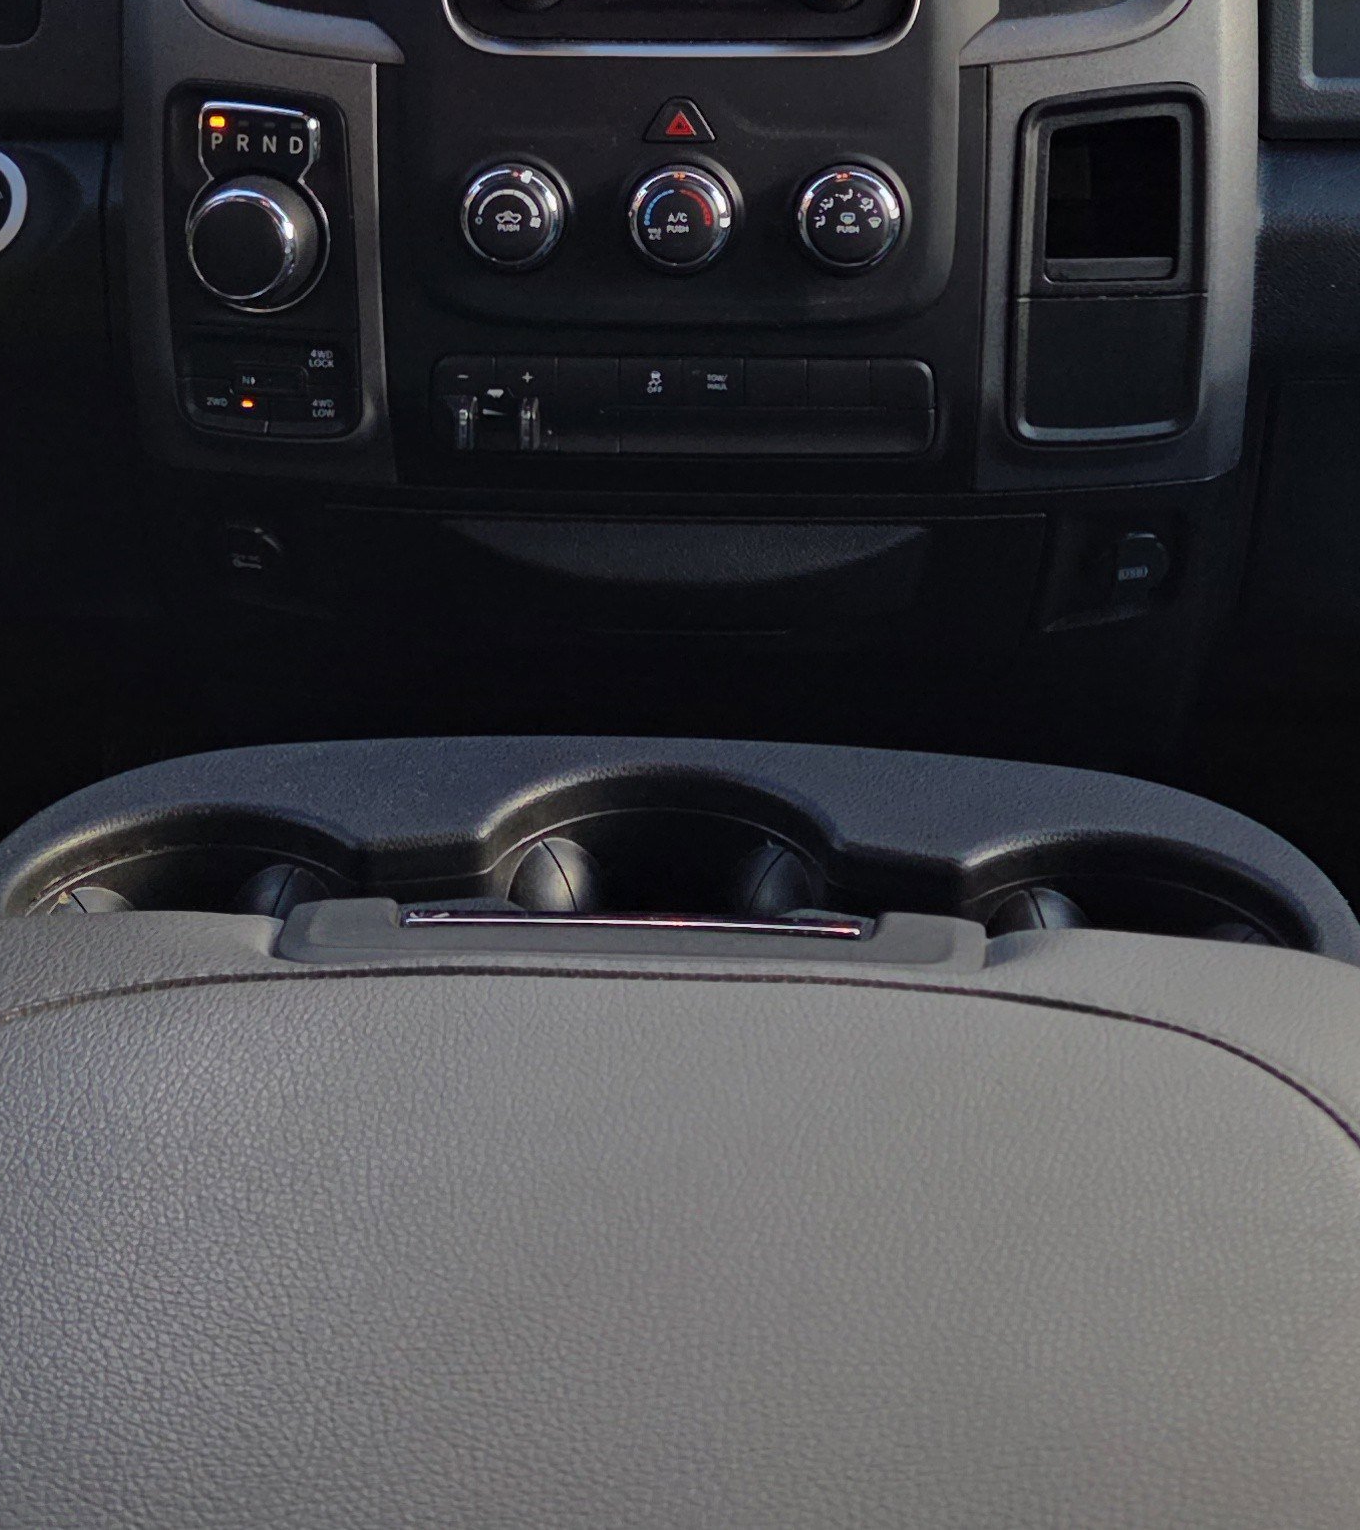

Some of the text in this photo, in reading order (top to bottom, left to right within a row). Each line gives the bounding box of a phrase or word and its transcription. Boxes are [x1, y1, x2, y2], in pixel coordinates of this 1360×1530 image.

[211, 134, 304, 155] P R N D
[667, 211, 688, 223] A/C
[496, 224, 520, 232] PUSH
[666, 225, 689, 234] PUSH
[836, 225, 860, 234] PUSH
[310, 349, 333, 359] 4WD
[308, 358, 335, 368] LOCK
[647, 385, 663, 394] OFF
[312, 398, 334, 408] 4WD
[312, 408, 335, 419] LOW
